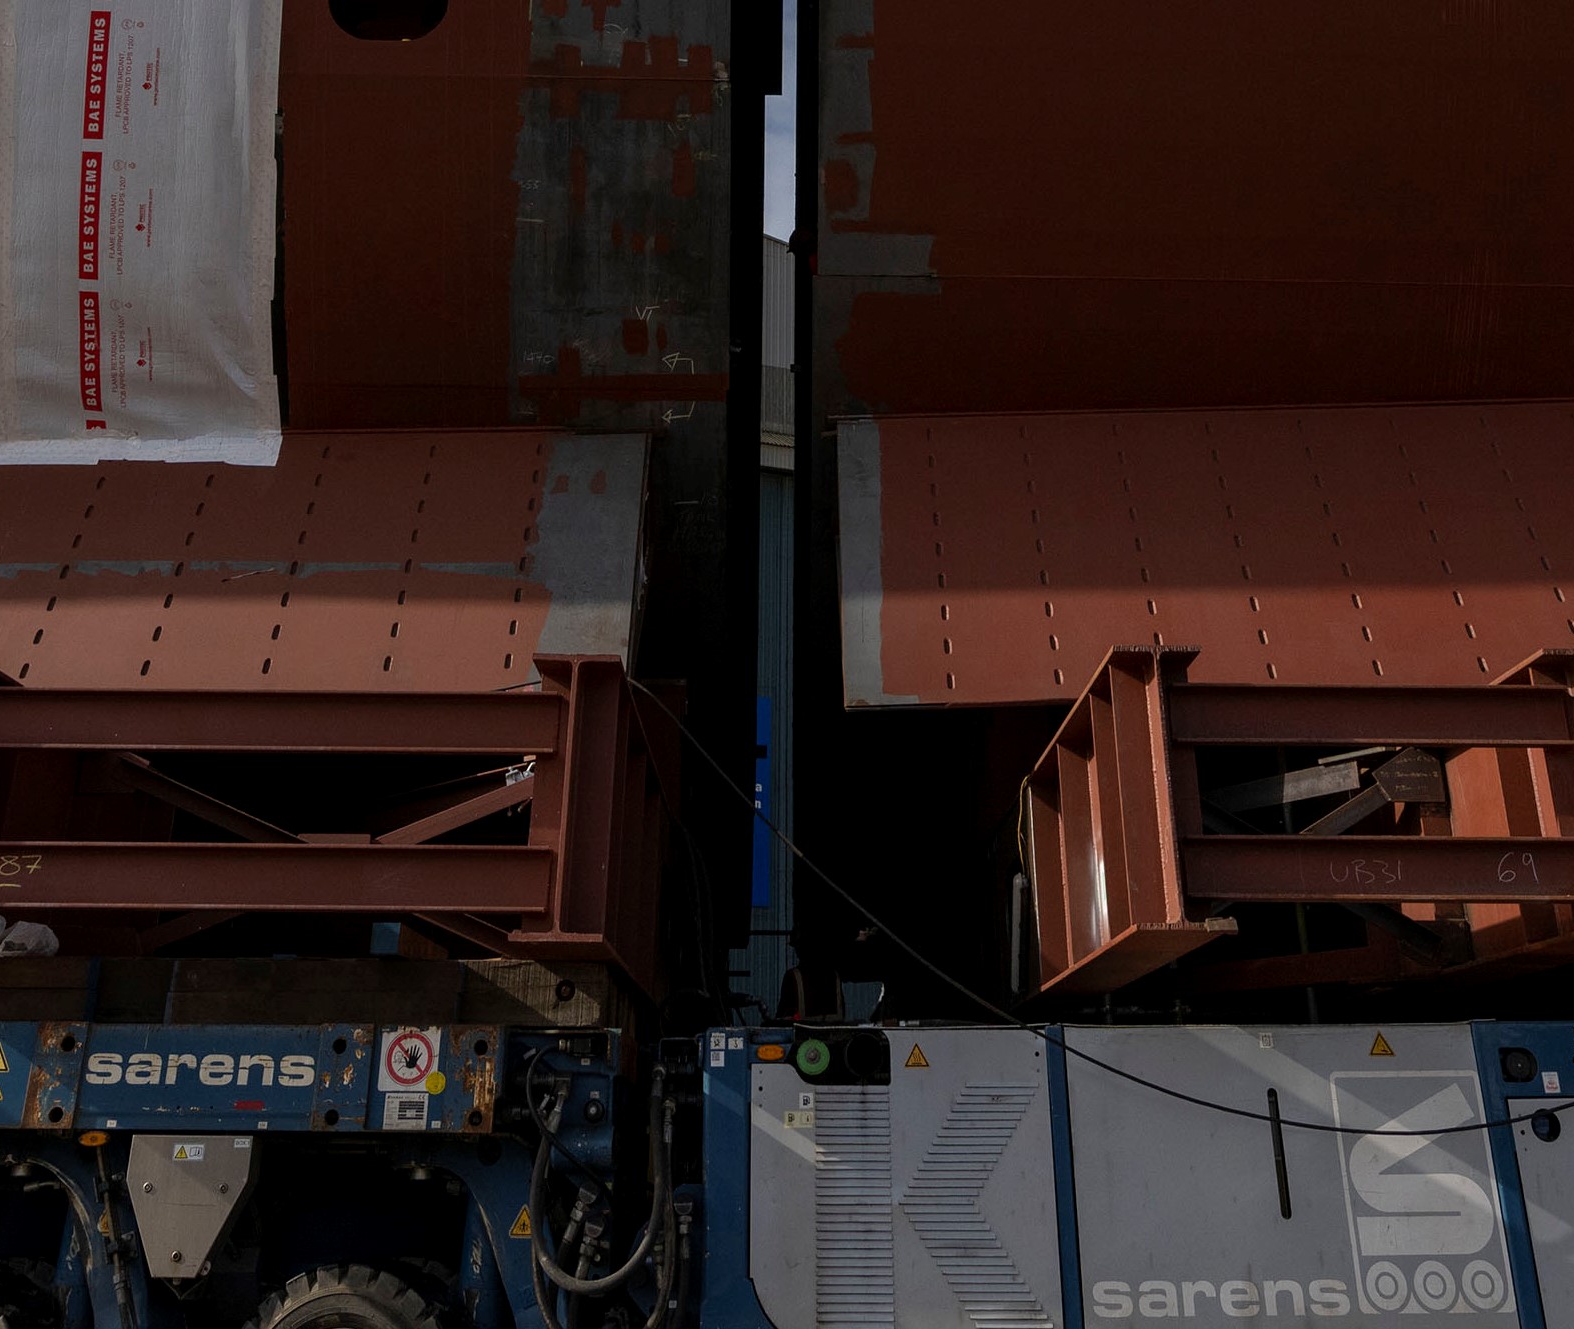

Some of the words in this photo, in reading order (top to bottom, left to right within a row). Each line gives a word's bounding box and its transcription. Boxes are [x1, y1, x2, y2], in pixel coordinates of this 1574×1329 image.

[89, 16, 107, 95] SYSTEMS
[87, 99, 101, 133] BAE
[83, 157, 98, 236] SYSTEMS
[83, 240, 95, 274] BAE
[83, 297, 97, 370] SYSTEMS
[84, 374, 98, 406] BAE
[1497, 852, 1540, 884] 69
[85, 1052, 316, 1088] sarens
[1092, 1277, 1351, 1319] sarens
